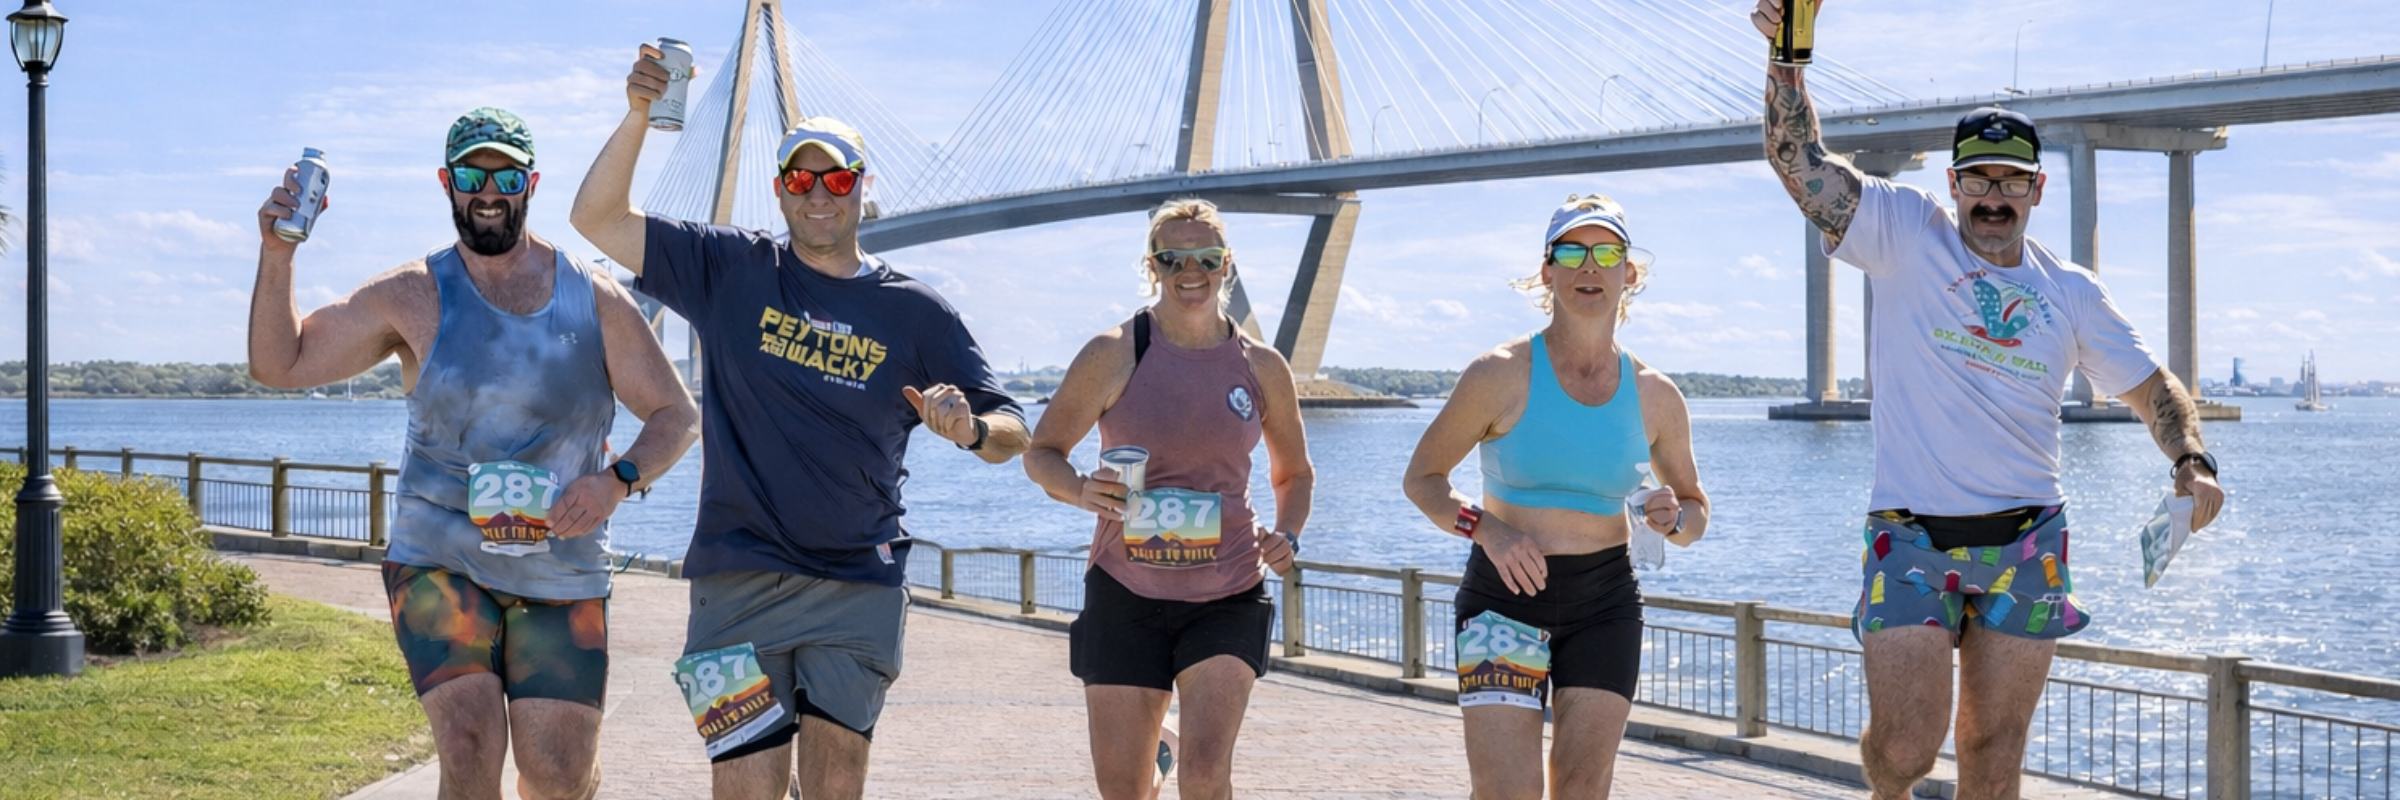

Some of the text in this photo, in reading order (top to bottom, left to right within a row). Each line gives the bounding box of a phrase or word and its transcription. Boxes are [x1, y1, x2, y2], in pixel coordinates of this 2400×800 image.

[759, 305, 888, 365] PEYTON'S
[786, 341, 877, 382] WACKY
[473, 472, 559, 509] 287
[1129, 497, 1215, 529] 287
[679, 653, 748, 709] 287
